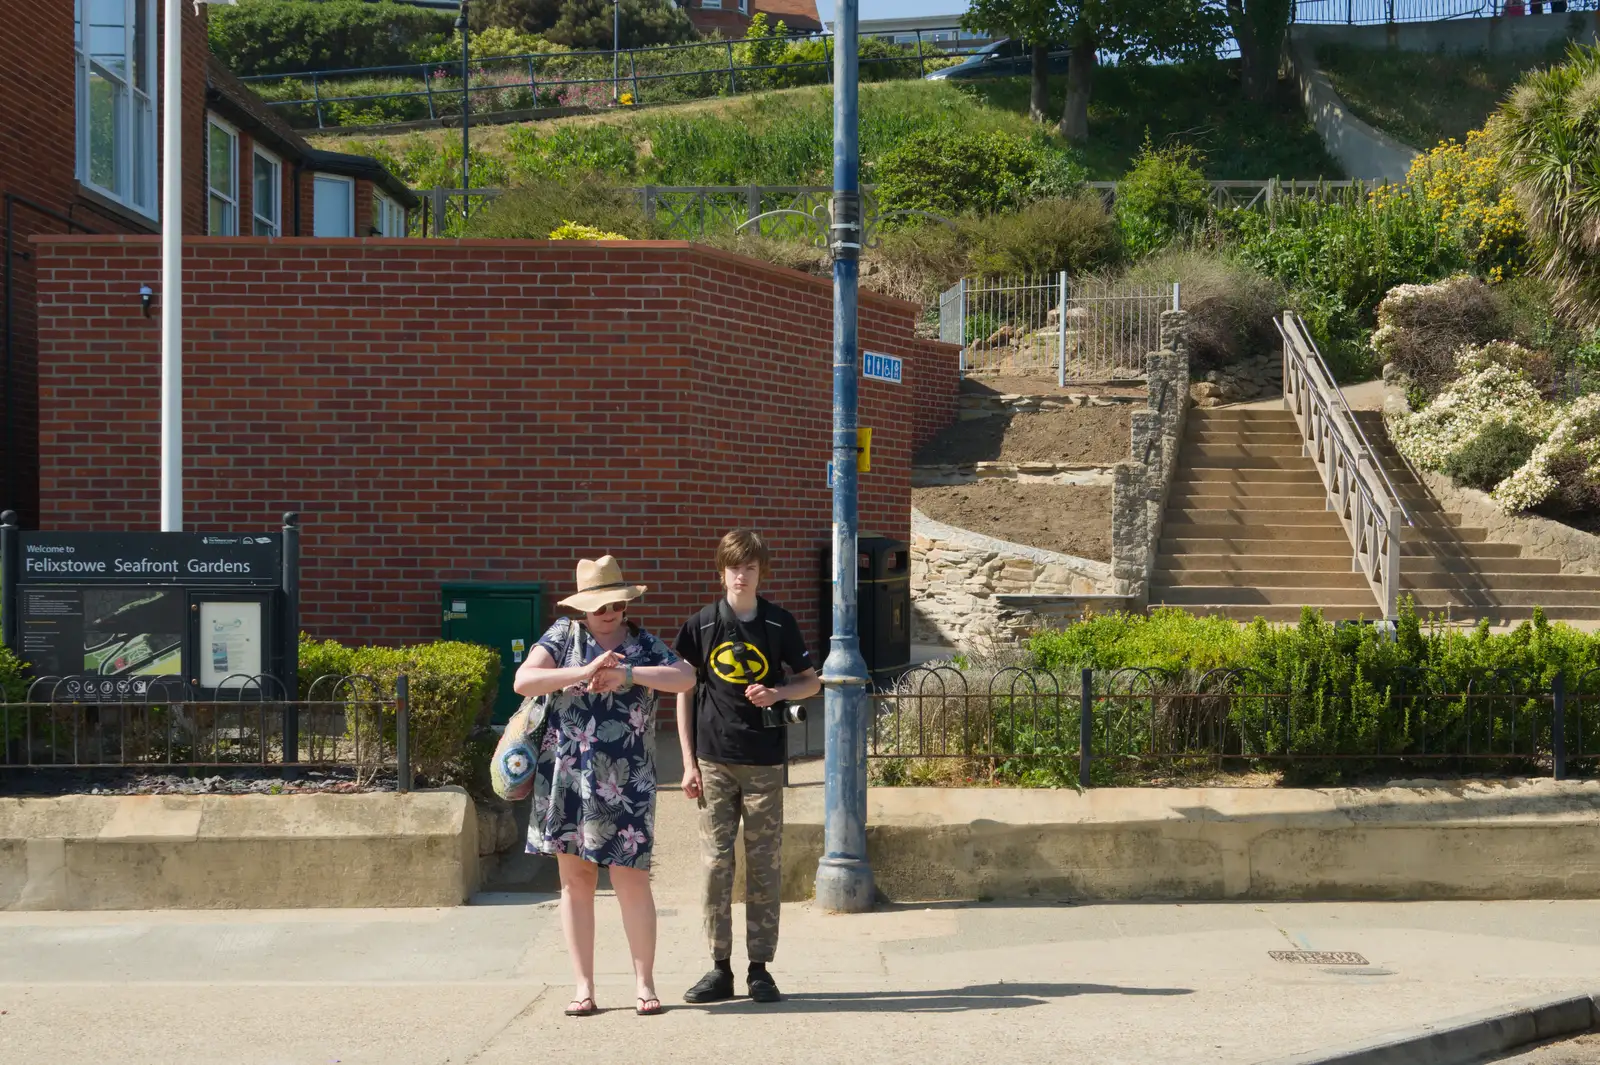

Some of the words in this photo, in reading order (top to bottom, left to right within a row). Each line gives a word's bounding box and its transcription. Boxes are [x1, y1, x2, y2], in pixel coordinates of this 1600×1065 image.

[26, 545, 65, 553] Welcome
[26, 558, 106, 572] Felixstowe
[114, 558, 179, 573] Seafront
[187, 558, 251, 573] Gardens
